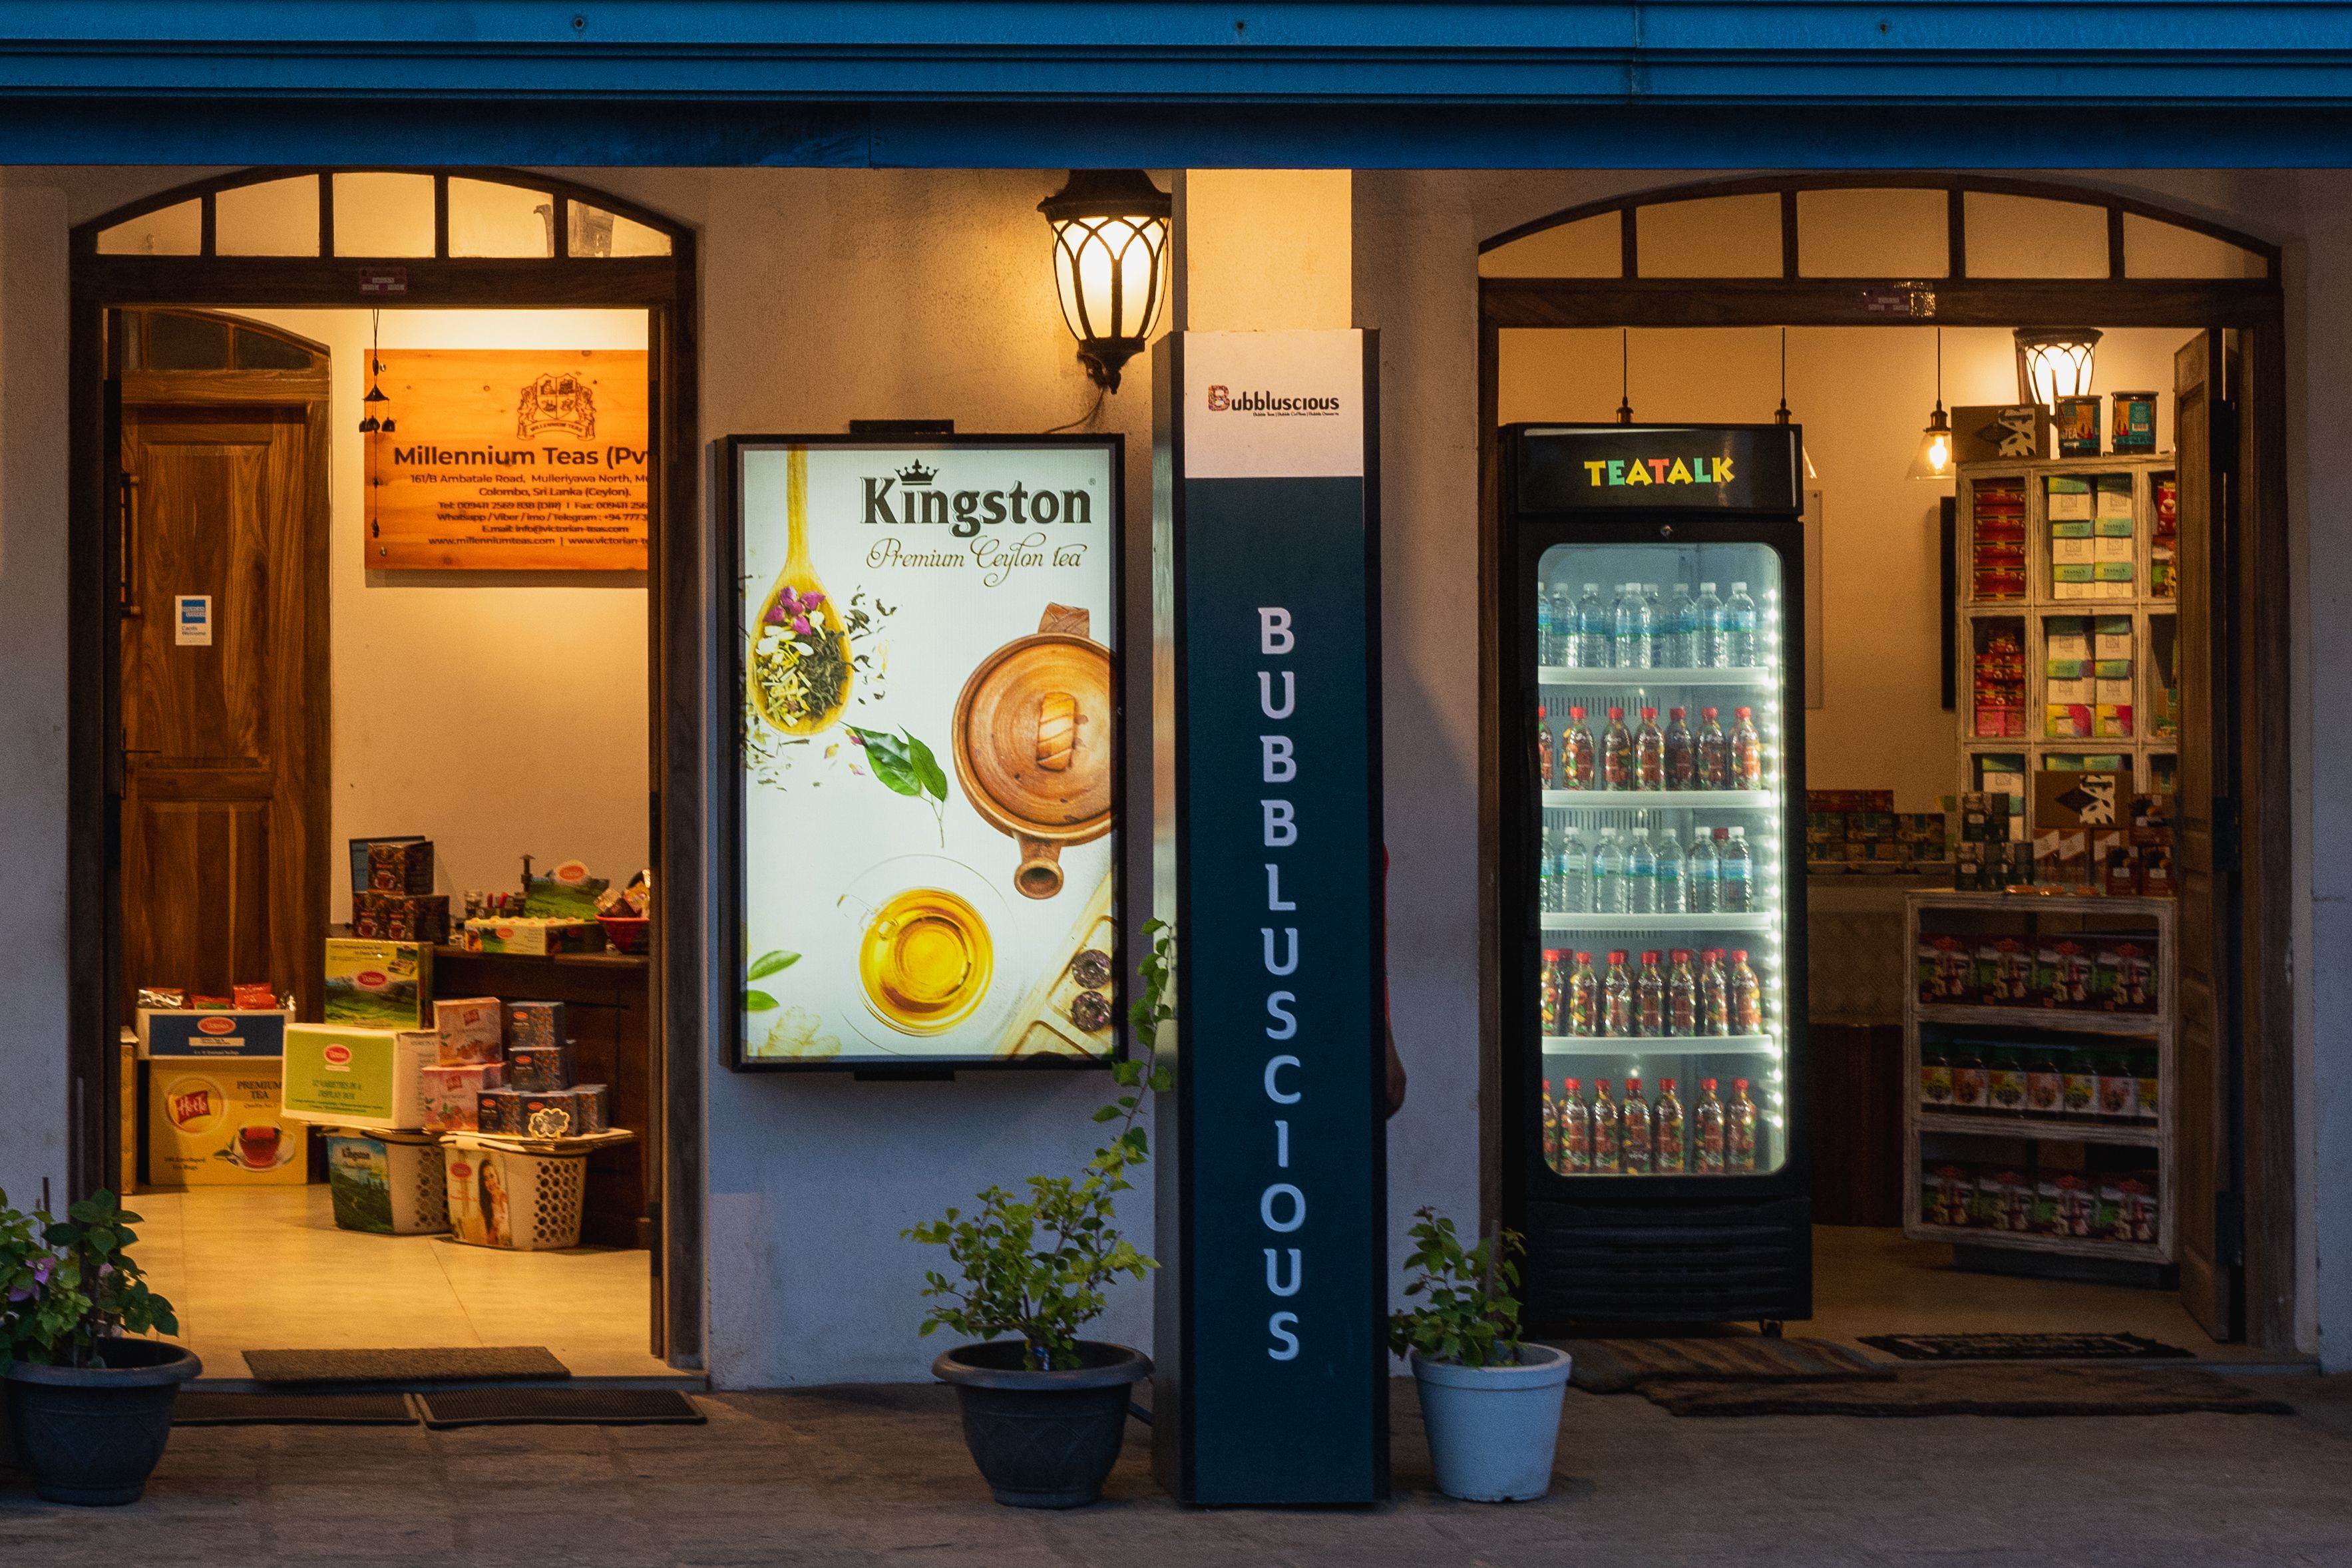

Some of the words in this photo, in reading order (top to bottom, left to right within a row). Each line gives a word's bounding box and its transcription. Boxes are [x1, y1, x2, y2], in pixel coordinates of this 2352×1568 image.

[1208, 385, 1339, 411] Bubbluscious
[394, 445, 534, 465] Millennium
[542, 447, 598, 465] Teas
[411, 474, 437, 483] 161/B
[440, 474, 492, 483] Ambatale
[496, 474, 525, 484] Road,
[532, 474, 596, 485] Mulleriyawa
[599, 474, 632, 484] North,
[1584, 457, 1736, 487] TEATALK
[479, 487, 530, 496] Colombo,
[533, 487, 547, 496] Sri
[550, 487, 582, 496] Lanka
[586, 487, 631, 498] (Ceylon).
[860, 476, 1091, 538] Kingston
[867, 538, 964, 569] Premium
[970, 532, 1047, 588] Ceylon
[1052, 544, 1087, 566] tea
[1257, 607, 1306, 1362] BUBBLUSCIOUS
[250, 1090, 270, 1099] TEA
